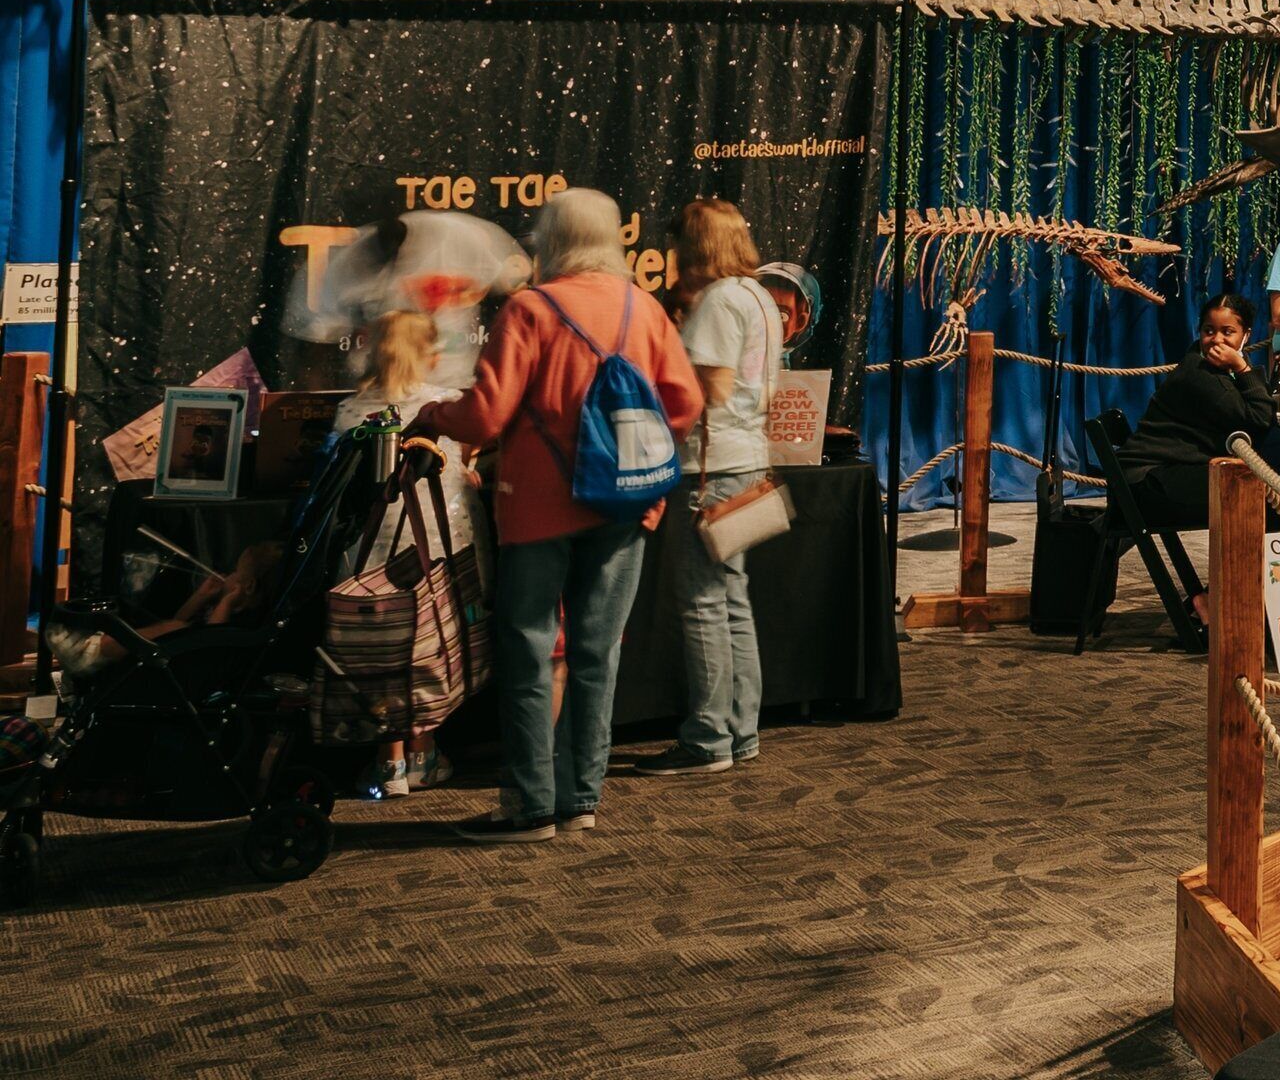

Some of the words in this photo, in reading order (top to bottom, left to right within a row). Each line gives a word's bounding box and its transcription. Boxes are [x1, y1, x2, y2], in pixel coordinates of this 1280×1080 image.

[694, 135, 865, 159] @taetaesworldofficial
[773, 389, 808, 399] ASK
[785, 411, 819, 420] GET
[773, 422, 816, 431] FREE
[769, 432, 814, 442] OOK!
